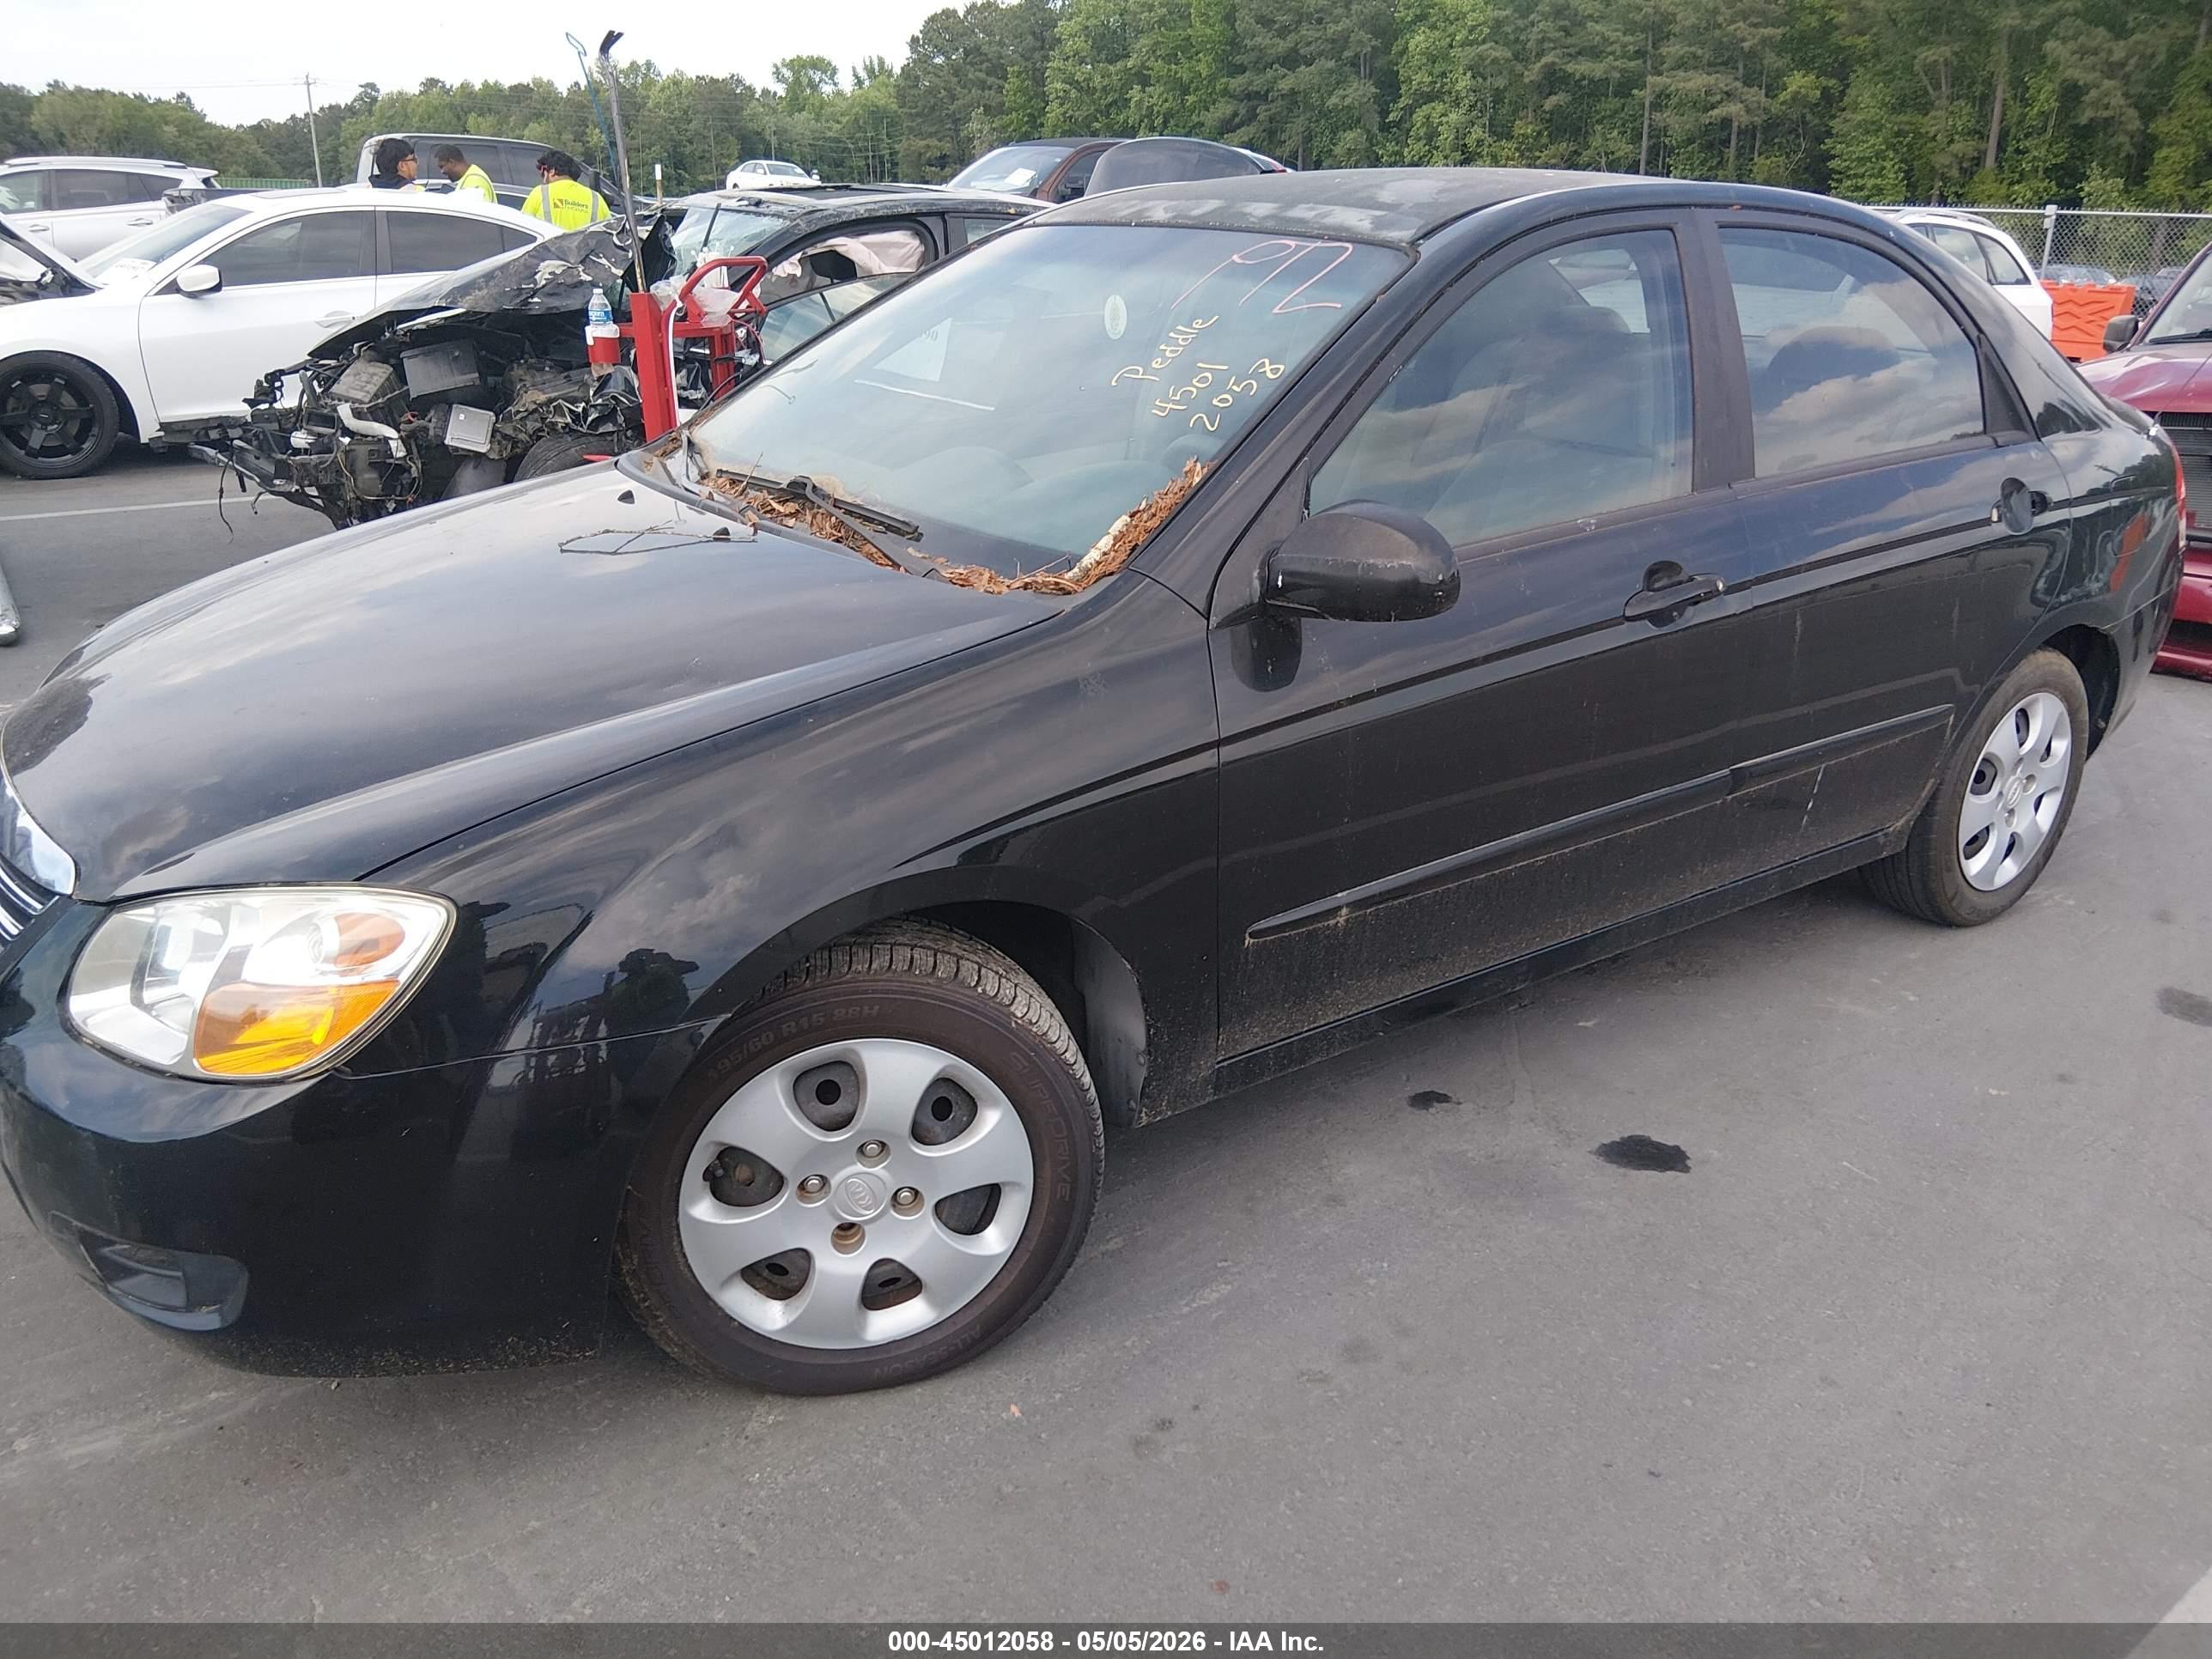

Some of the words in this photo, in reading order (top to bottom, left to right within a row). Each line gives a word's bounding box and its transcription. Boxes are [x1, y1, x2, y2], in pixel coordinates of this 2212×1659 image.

[1111, 314, 1219, 386] Peddle
[1151, 362, 1230, 417] 4501
[1189, 357, 1285, 432] 2058
[780, 1012, 826, 1039] R15
[830, 1005, 880, 1022] 88H
